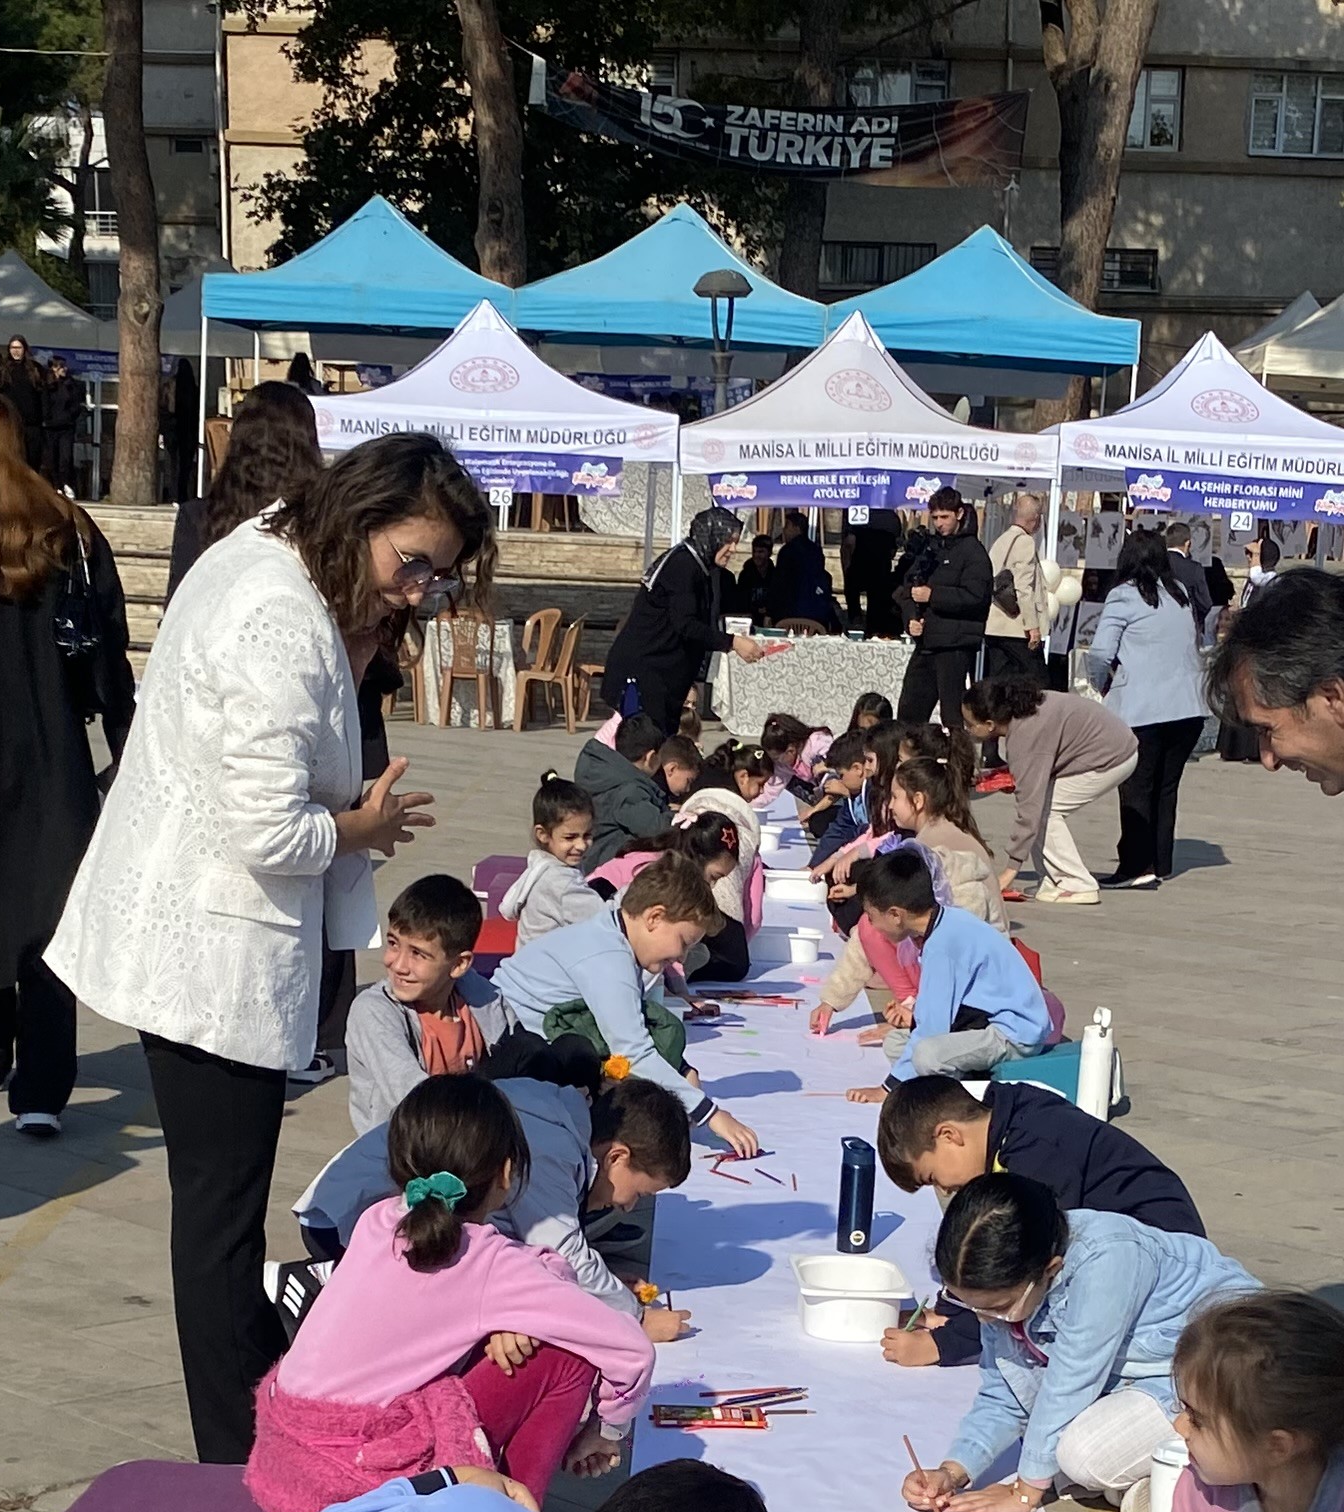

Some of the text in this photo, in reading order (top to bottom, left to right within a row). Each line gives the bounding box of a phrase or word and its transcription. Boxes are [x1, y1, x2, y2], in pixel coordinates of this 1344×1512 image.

[724, 126, 896, 169] TÜRKİYE
[340, 418, 401, 436] MANİSA
[468, 424, 522, 444] EĞİTİM
[526, 427, 627, 446] MÜDÜRLÜĞÜ
[739, 437, 1000, 462] MANİSA İL MİLLİ EĞİTİM MÜDÜRLÜĞÜ
[1104, 443, 1164, 463] MANİSA
[1167, 446, 1180, 464] İL
[1184, 448, 1223, 467] MİLLİ
[1227, 453, 1278, 472] EĞİTİM
[780, 474, 891, 487] RENKLERLE ETKİLEŞİM
[491, 490, 511, 504] 26
[813, 487, 861, 499] ATÖLYESİ
[1179, 479, 1232, 495] ALAŞEHİR
[1233, 484, 1278, 498] FLORASI
[1278, 485, 1304, 499] MİNİ
[1203, 496, 1278, 512] HERBERYUMU
[850, 507, 868, 522] 25
[1232, 514, 1252, 529] 24
